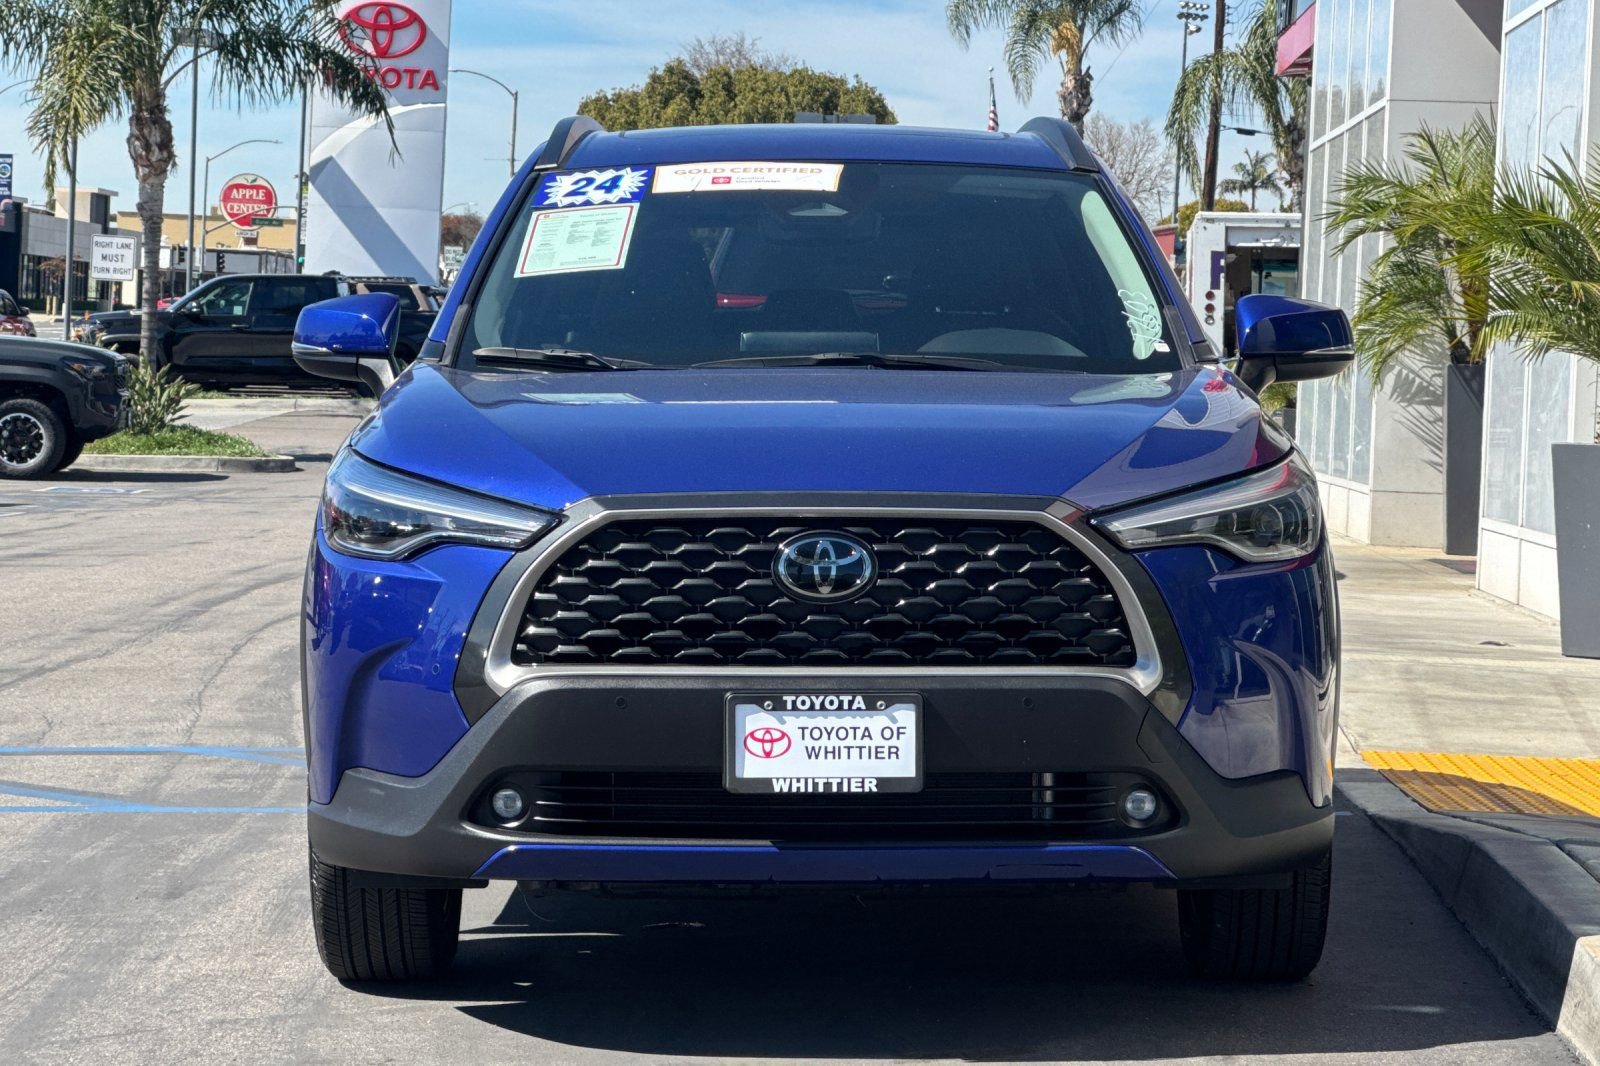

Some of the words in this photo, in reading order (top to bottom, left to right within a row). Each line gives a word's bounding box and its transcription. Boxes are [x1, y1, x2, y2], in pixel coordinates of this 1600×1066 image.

[562, 174, 624, 198] 24
[231, 188, 266, 200] APPLE
[226, 202, 268, 215] CENTER
[94, 241, 113, 249] RIGHT
[101, 253, 125, 263] MUST
[93, 266, 110, 274] TURN
[112, 267, 131, 275] RIGHT
[782, 695, 866, 711] TOYOTA
[797, 726, 873, 741] TOYOTA
[880, 726, 907, 741] OF
[805, 745, 900, 760] WHITTIER
[771, 777, 878, 793] WHITTIER
